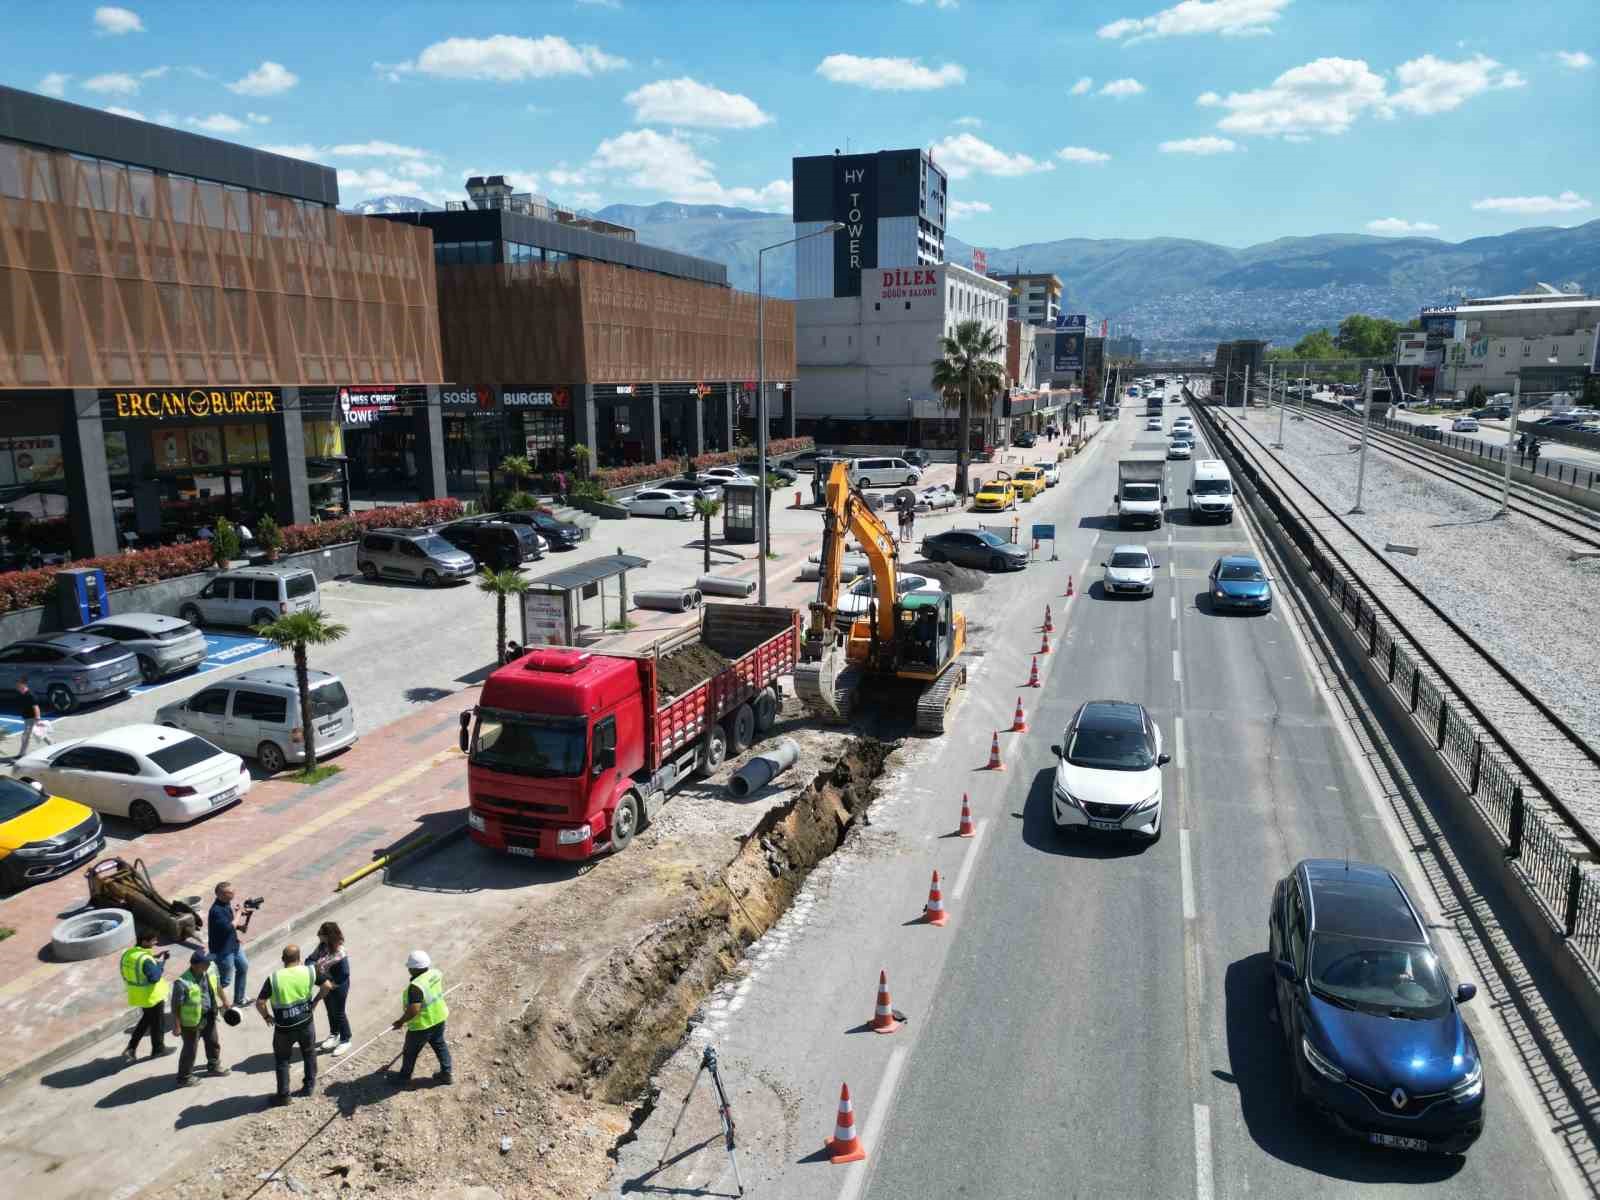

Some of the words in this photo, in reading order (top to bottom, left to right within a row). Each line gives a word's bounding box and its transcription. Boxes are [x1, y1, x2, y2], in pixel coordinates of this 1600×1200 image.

[845, 169, 865, 184] HY
[848, 193, 863, 269] TOWER
[882, 269, 937, 287] DİLEK
[115, 392, 187, 417] ERCAN
[210, 391, 276, 414] BURGER
[503, 391, 554, 406] BURGER
[343, 409, 380, 424] TOWER
